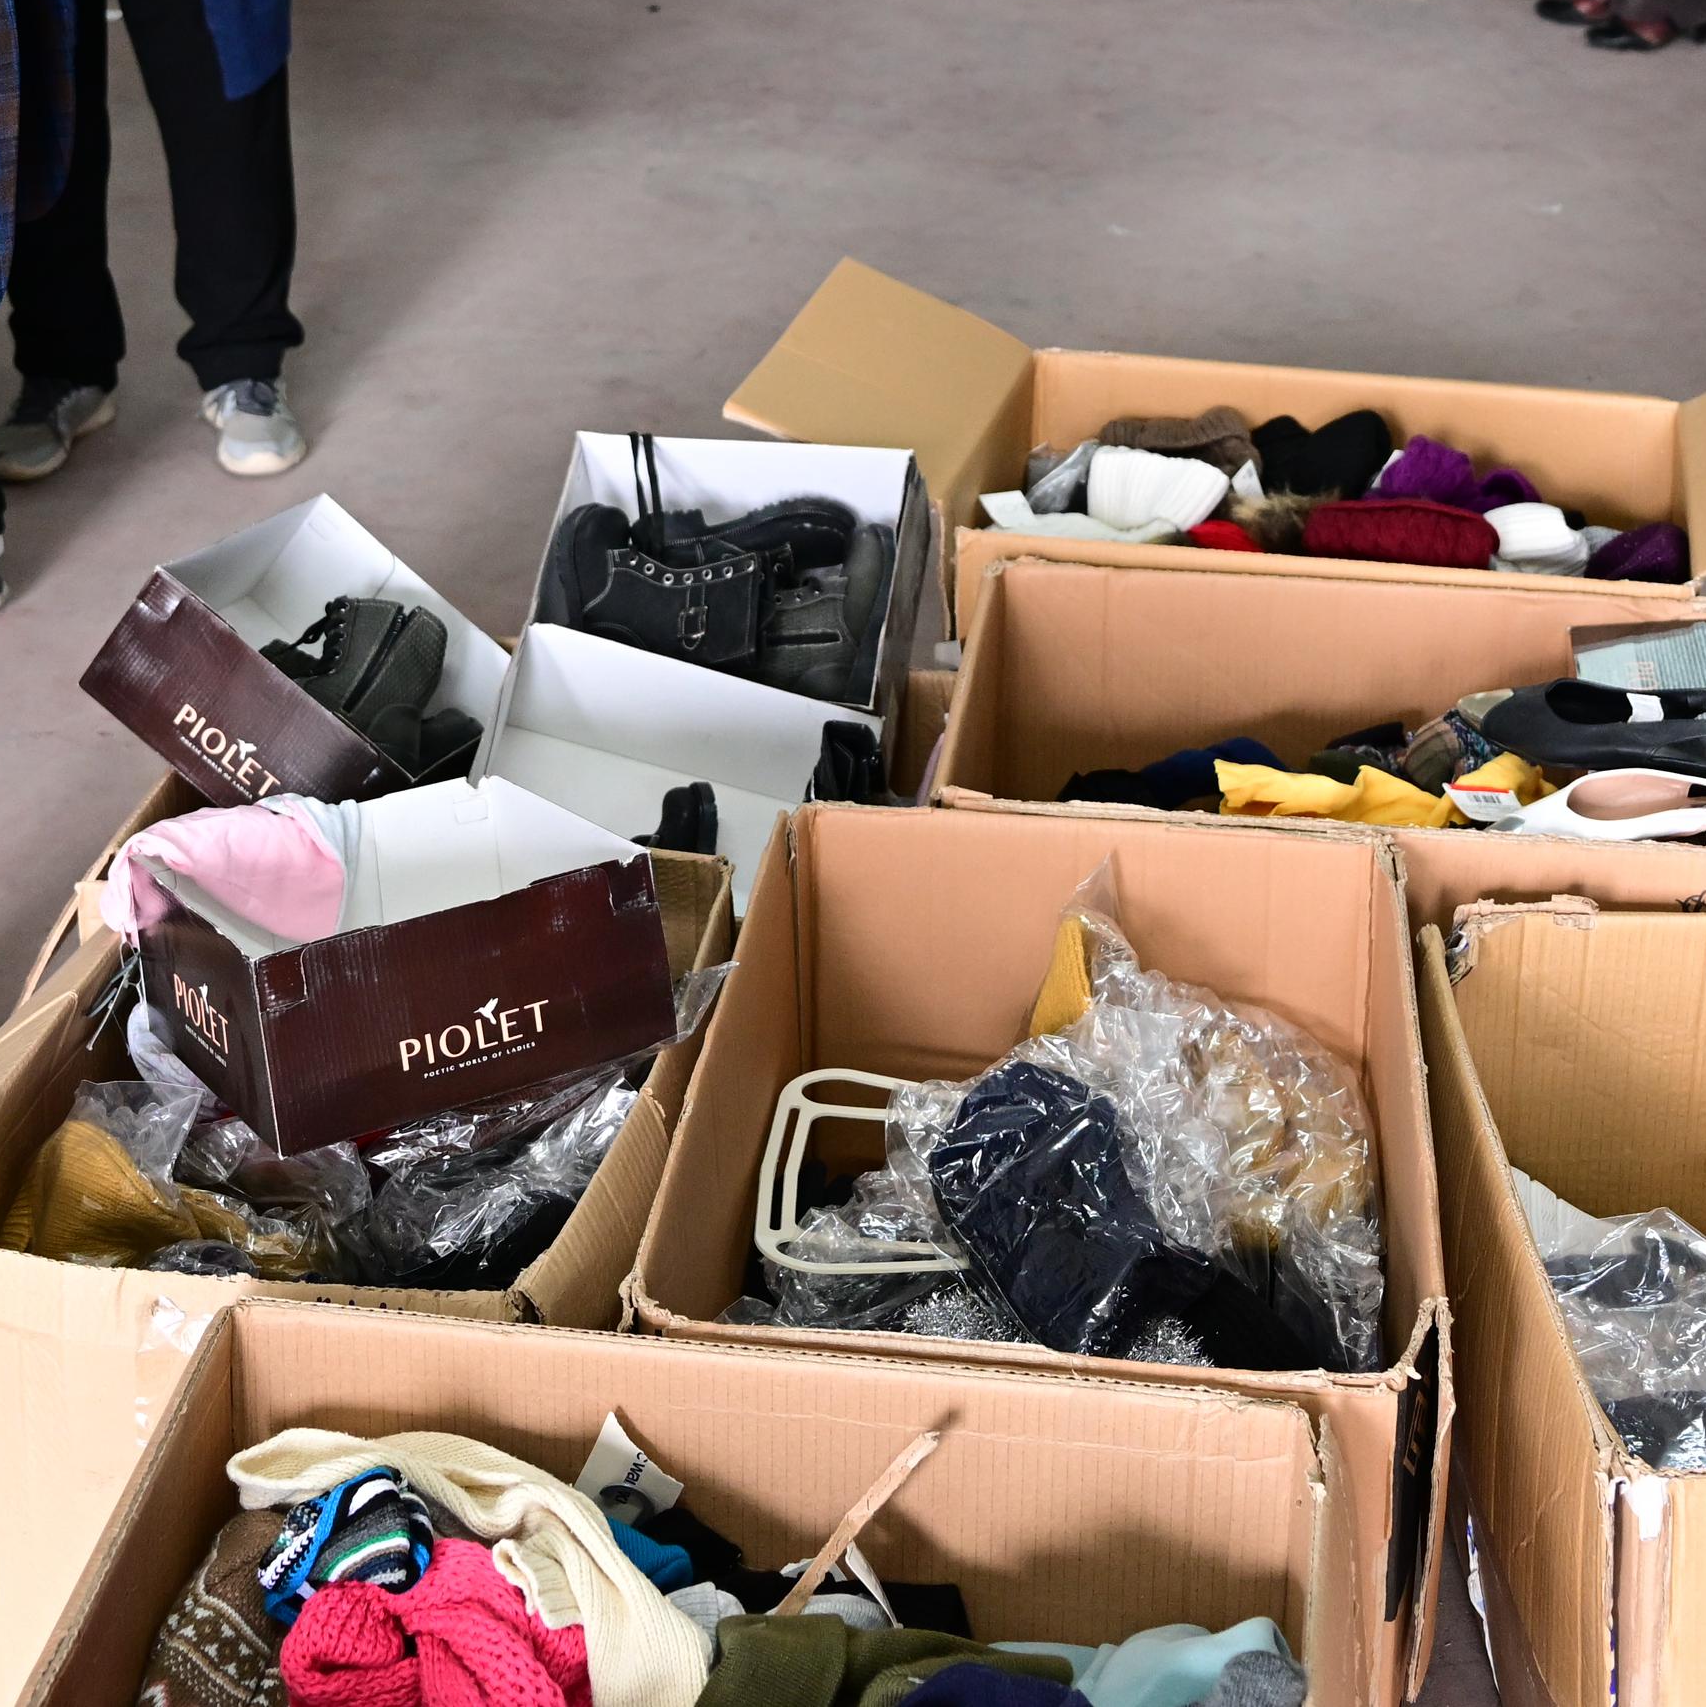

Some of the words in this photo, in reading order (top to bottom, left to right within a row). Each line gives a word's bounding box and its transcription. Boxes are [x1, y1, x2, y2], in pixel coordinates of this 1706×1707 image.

[173, 703, 281, 796] PIOLET
[173, 973, 229, 1054] PIOLET
[398, 999, 550, 1072] PIOLET
[423, 1064, 456, 1079] POETIC
[458, 1055, 488, 1068] WORLD
[492, 1051, 503, 1059] OF
[506, 1041, 536, 1055] LADIES
